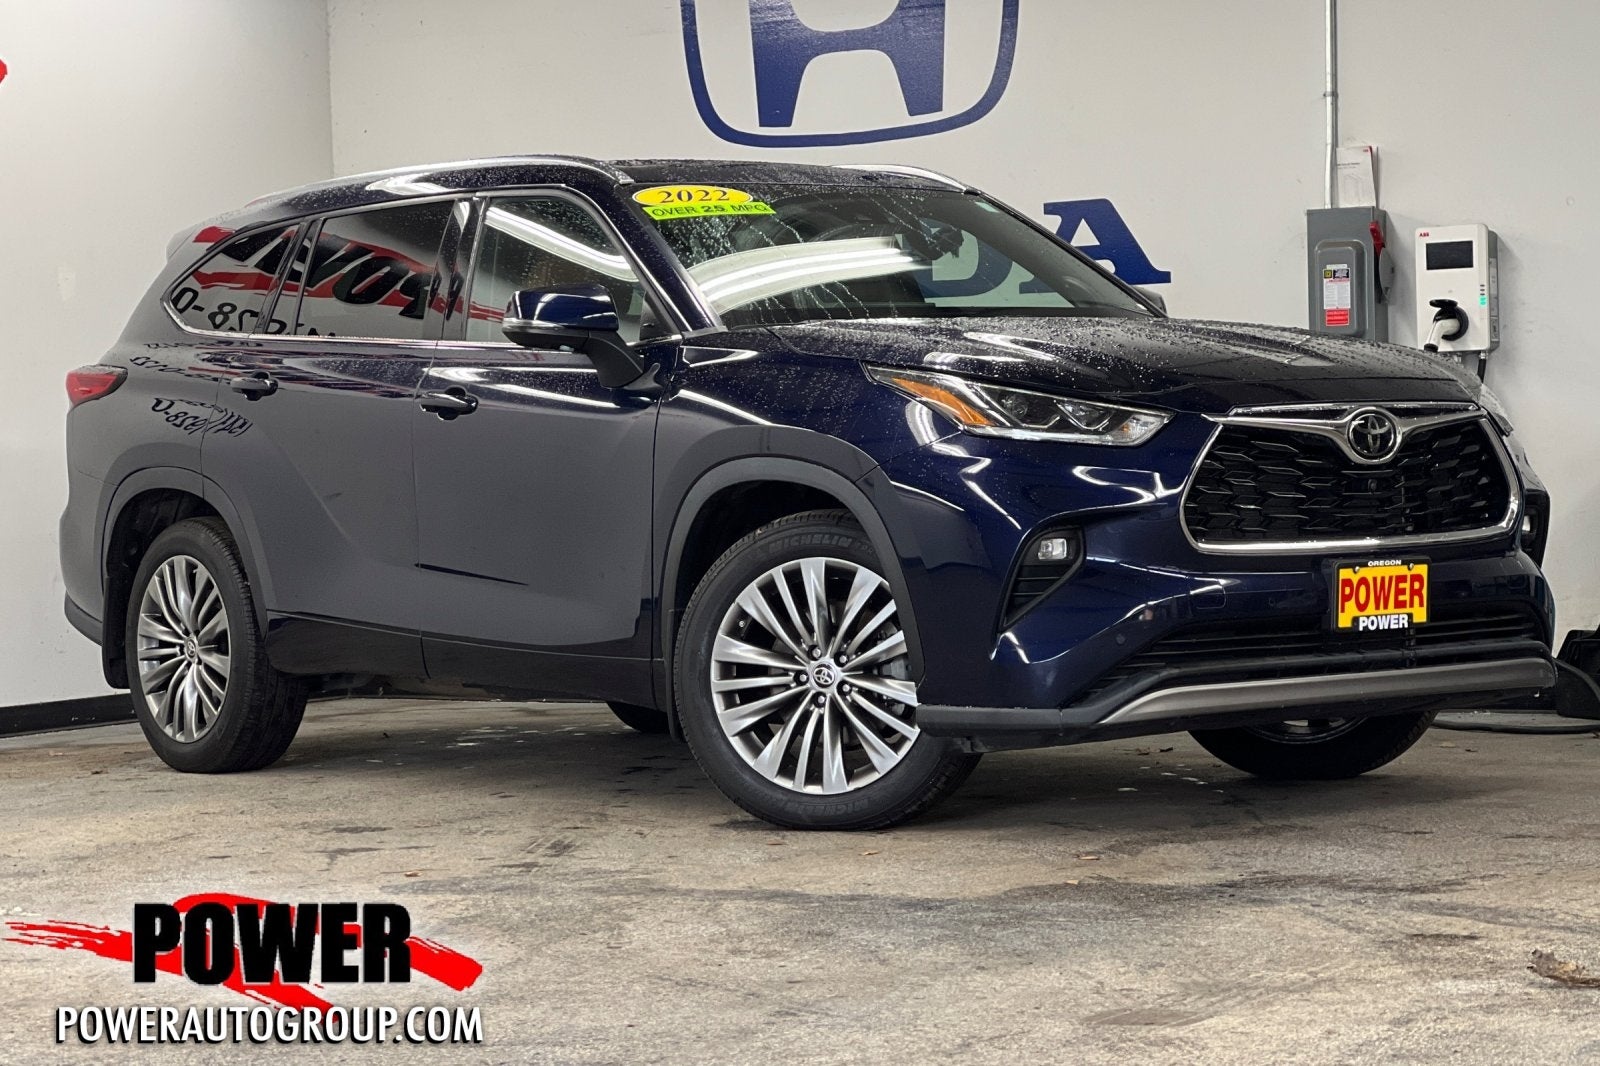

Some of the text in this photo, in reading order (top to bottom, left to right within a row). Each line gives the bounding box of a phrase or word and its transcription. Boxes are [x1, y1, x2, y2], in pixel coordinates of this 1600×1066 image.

[657, 189, 730, 203] 2022
[652, 205, 697, 216] OVER
[700, 204, 725, 213] 25
[768, 533, 853, 554] MICHELIN
[1340, 573, 1425, 613] POWER
[1359, 613, 1409, 631] POWER
